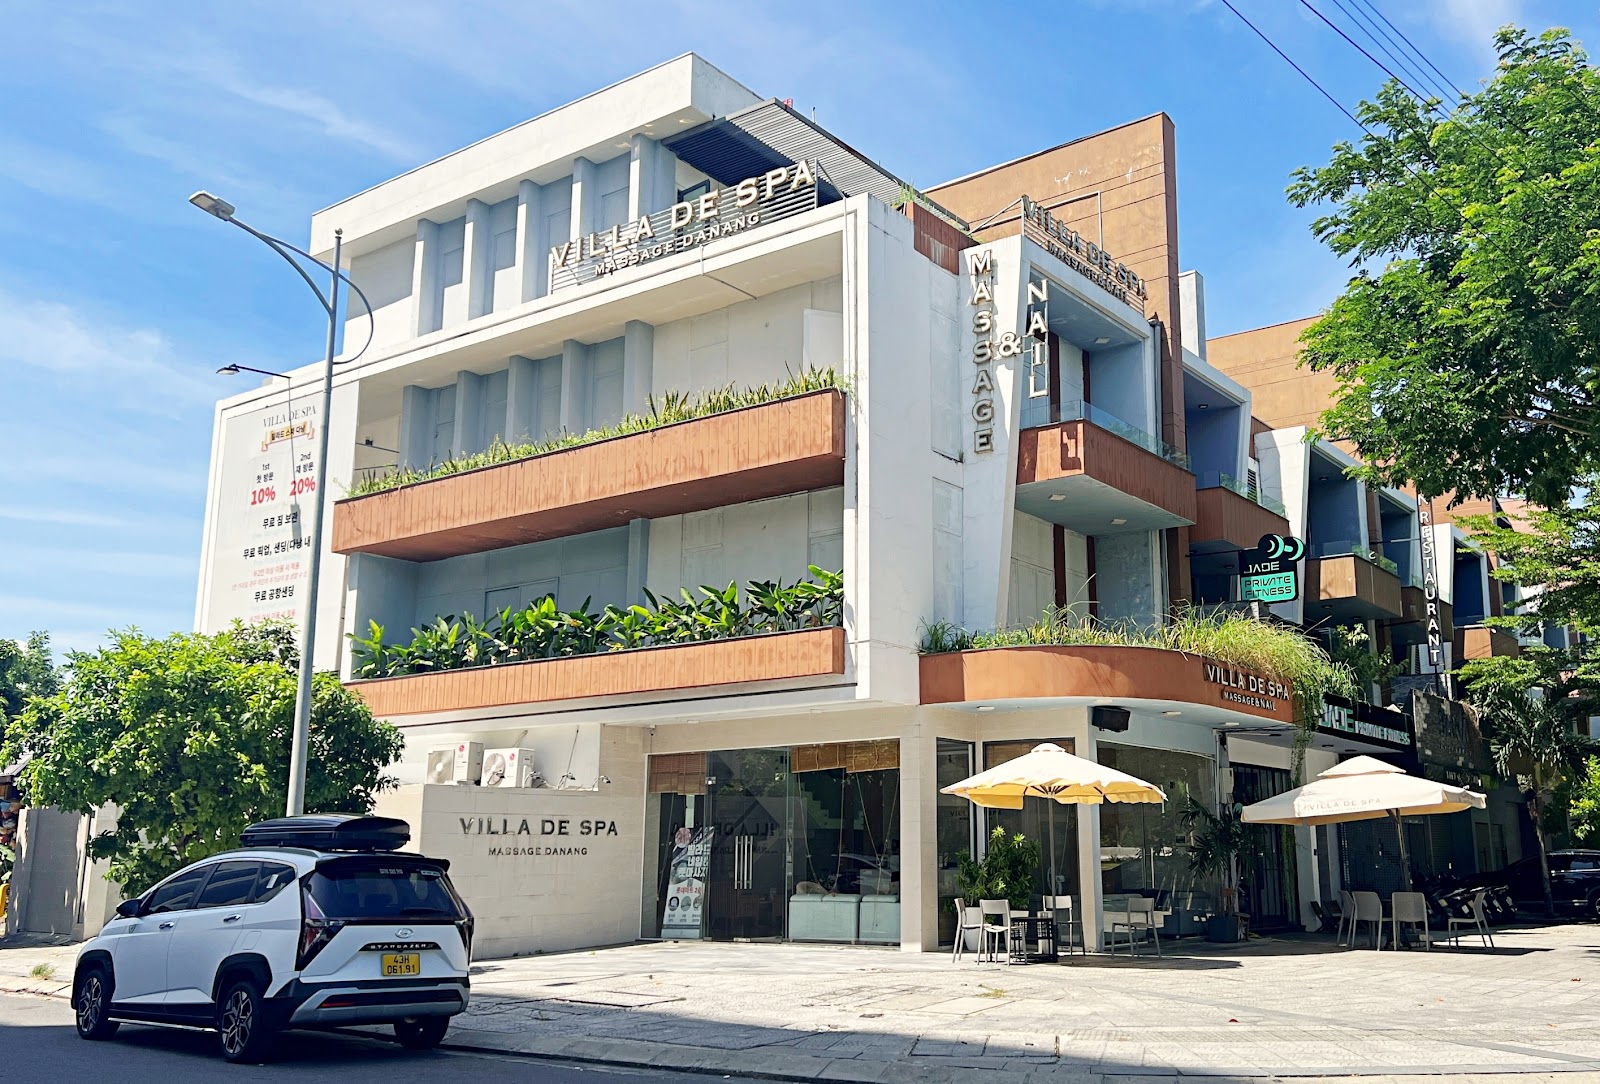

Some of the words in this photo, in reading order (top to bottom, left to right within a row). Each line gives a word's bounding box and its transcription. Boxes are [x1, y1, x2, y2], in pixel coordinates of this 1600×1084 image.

[551, 214, 655, 268] VILLA
[670, 189, 721, 230] DE
[734, 158, 816, 208] SPA
[594, 239, 677, 276] MASSAGE
[682, 211, 761, 248] DANANG
[1021, 194, 1082, 255] VILLA
[1087, 241, 1112, 275] DE
[1115, 262, 1148, 301] SPA
[999, 331, 1022, 358] &
[1027, 278, 1049, 399] NAIL
[970, 250, 994, 455] MASSAGE
[263, 414, 286, 427] VILLA
[289, 409, 300, 421] DE
[301, 405, 316, 417] SPA
[300, 451, 311, 461] 2nd
[250, 486, 276, 505] 10%
[289, 476, 316, 497] 20%
[262, 517, 275, 529] 무료
[243, 547, 256, 559] 무료
[1244, 561, 1280, 574] JADE
[1244, 575, 1291, 589] PRIVATE
[1419, 511, 1440, 663] RESTAURANT
[254, 590, 267, 602] 무료
[1245, 585, 1292, 599] FITNESS
[1207, 664, 1245, 690] VILLA
[1249, 676, 1265, 694] DE
[1268, 680, 1290, 700] SPA
[1223, 691, 1277, 711] MASSAGE&NAIL
[1309, 801, 1340, 810] VILLA
[1361, 798, 1381, 806] SPA
[459, 818, 531, 835] VILLA
[540, 820, 570, 835] DE
[579, 820, 618, 836] SPA
[488, 847, 541, 856] MASSAGE
[544, 847, 588, 856] DANANG
[393, 955, 410, 964] 43H
[387, 965, 416, 975] 061.91
